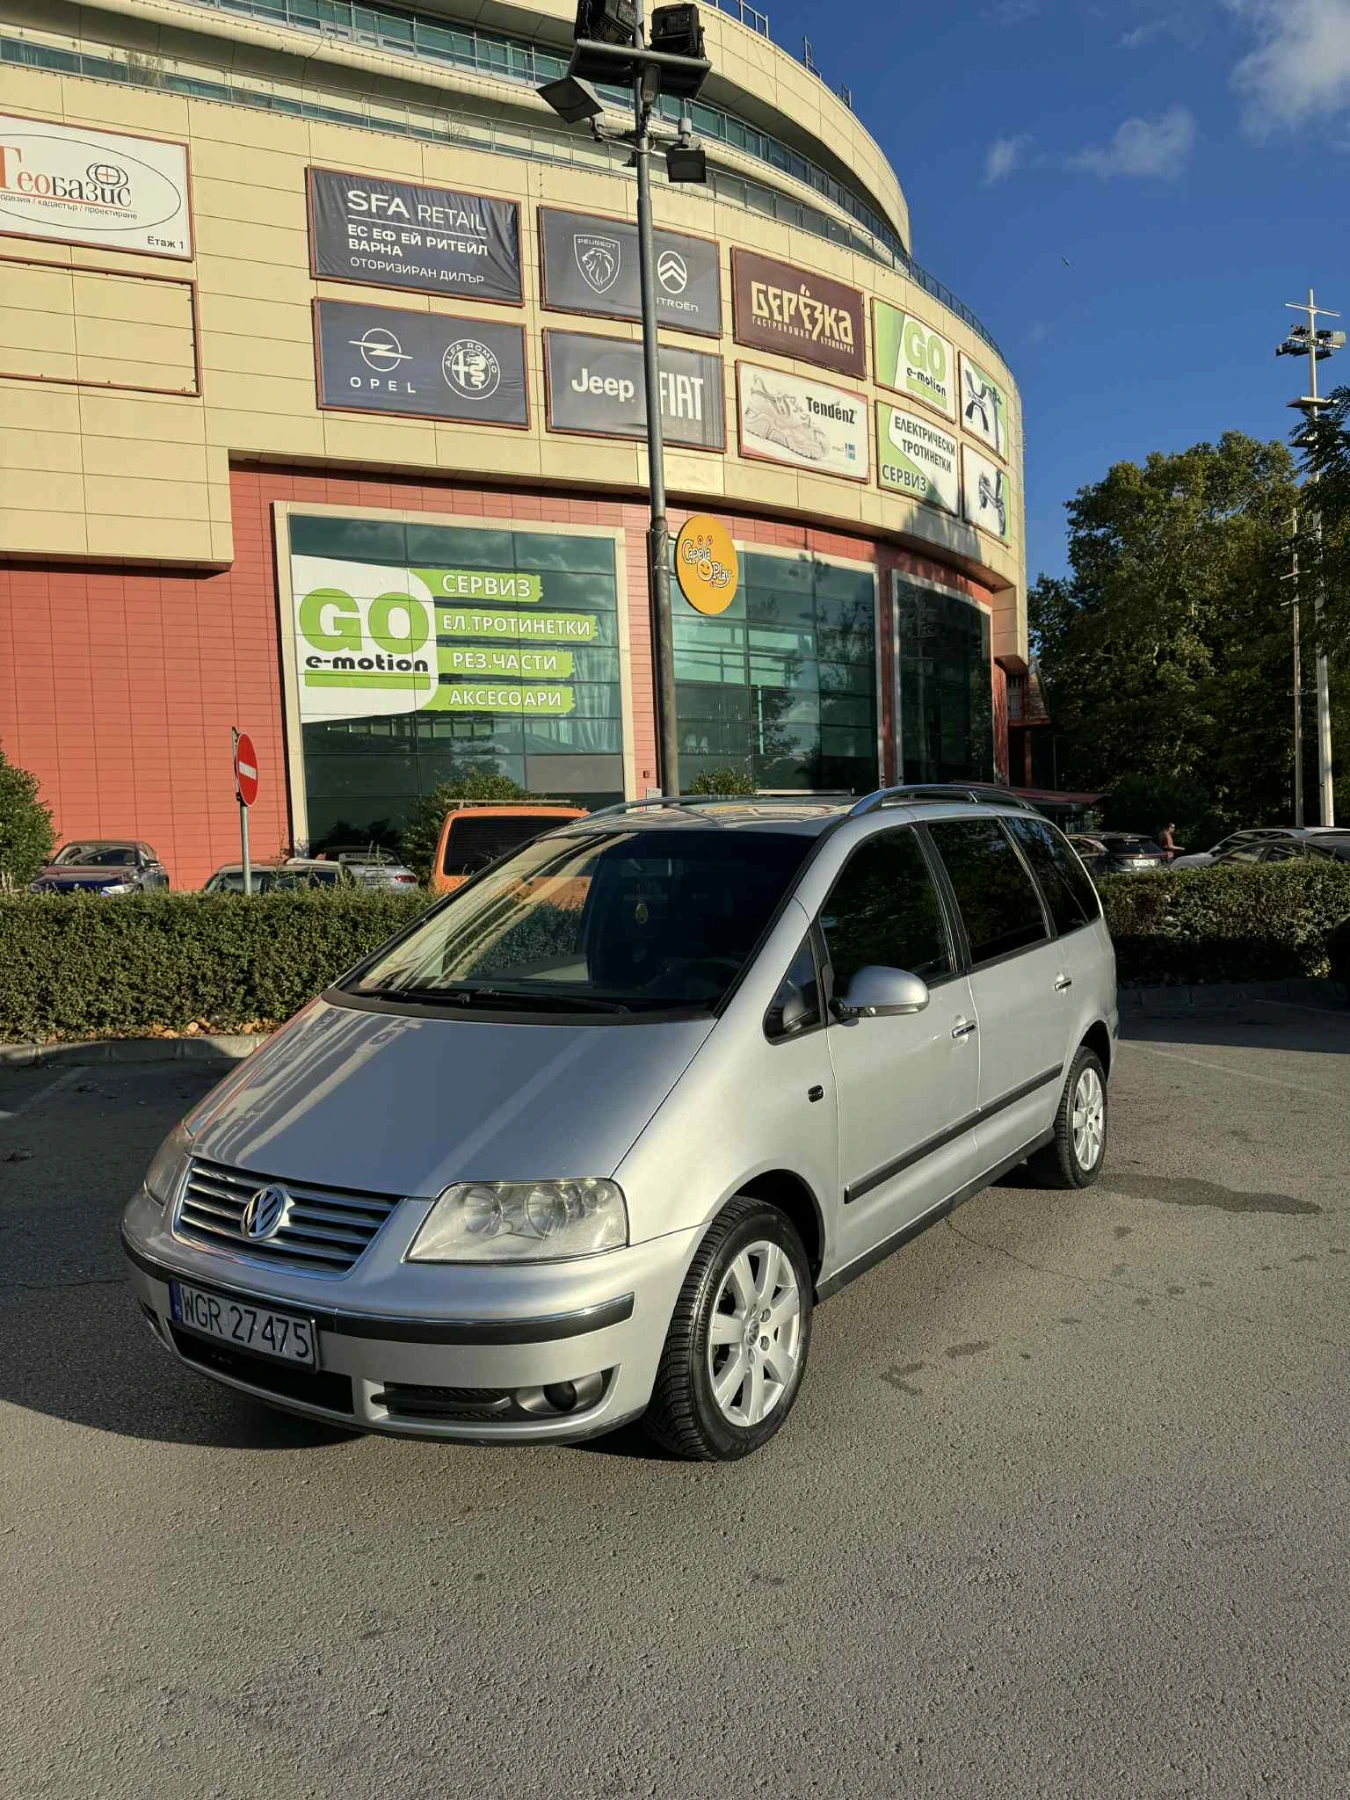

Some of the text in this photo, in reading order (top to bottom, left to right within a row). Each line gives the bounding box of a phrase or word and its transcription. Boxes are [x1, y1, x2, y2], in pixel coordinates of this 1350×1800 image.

[347, 190, 487, 231] SFA RETAIL
[147, 235, 184, 249] Етаж 1
[347, 223, 488, 256] ЕС ЕФ ЕЙ РИТЕЙЛ
[348, 238, 403, 257] ВАРНА
[577, 238, 617, 250] PEUGEOT
[350, 256, 485, 285] ОТОРИЗИРАН ДИЛЪР
[444, 342, 497, 373] ALFA ROMEO
[903, 321, 946, 382] GO
[349, 376, 416, 394] OPEL
[571, 368, 635, 402] Jeep
[659, 371, 704, 420] FIAT
[906, 367, 946, 397] e-motion
[894, 415, 956, 457] ЕЛЕКТРИЧЕСКИ
[901, 438, 952, 473] ТРОТИНЕТКИ
[881, 464, 927, 492] СЕРВИЗ
[441, 574, 531, 598] СЕРВИЗ
[299, 587, 429, 654] GO
[442, 614, 591, 636] ЕЛ.ТРОТИНЕТКИ
[305, 654, 429, 673] e-motion
[452, 651, 558, 671] РЕЗ.ЧАСТИ
[449, 689, 562, 707] АКСЕСОАРИ
[181, 1287, 309, 1358] WGR 27475
